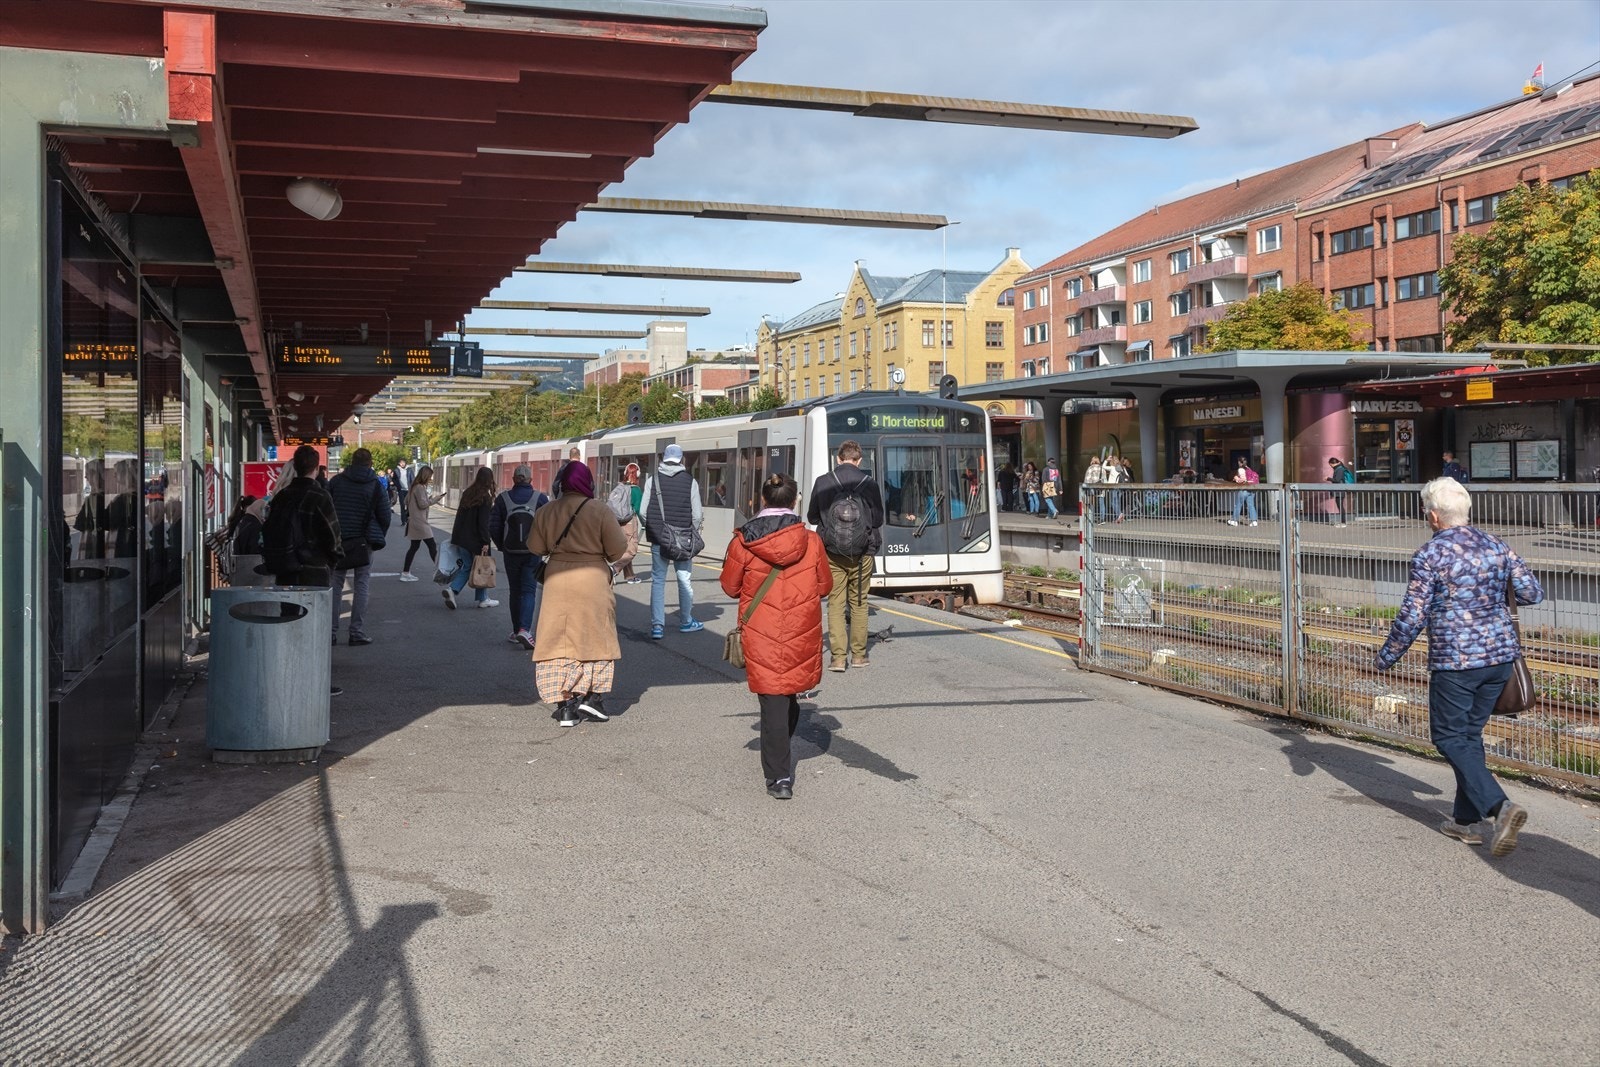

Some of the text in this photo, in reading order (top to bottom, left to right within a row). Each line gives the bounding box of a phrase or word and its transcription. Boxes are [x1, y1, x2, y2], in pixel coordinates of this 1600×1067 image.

[465, 349, 472, 366] 1
[1193, 406, 1242, 420] NARVESEN
[1350, 401, 1423, 413] NARVESEN
[871, 415, 945, 427] 3 Mortensrud
[887, 544, 910, 553] 3356
